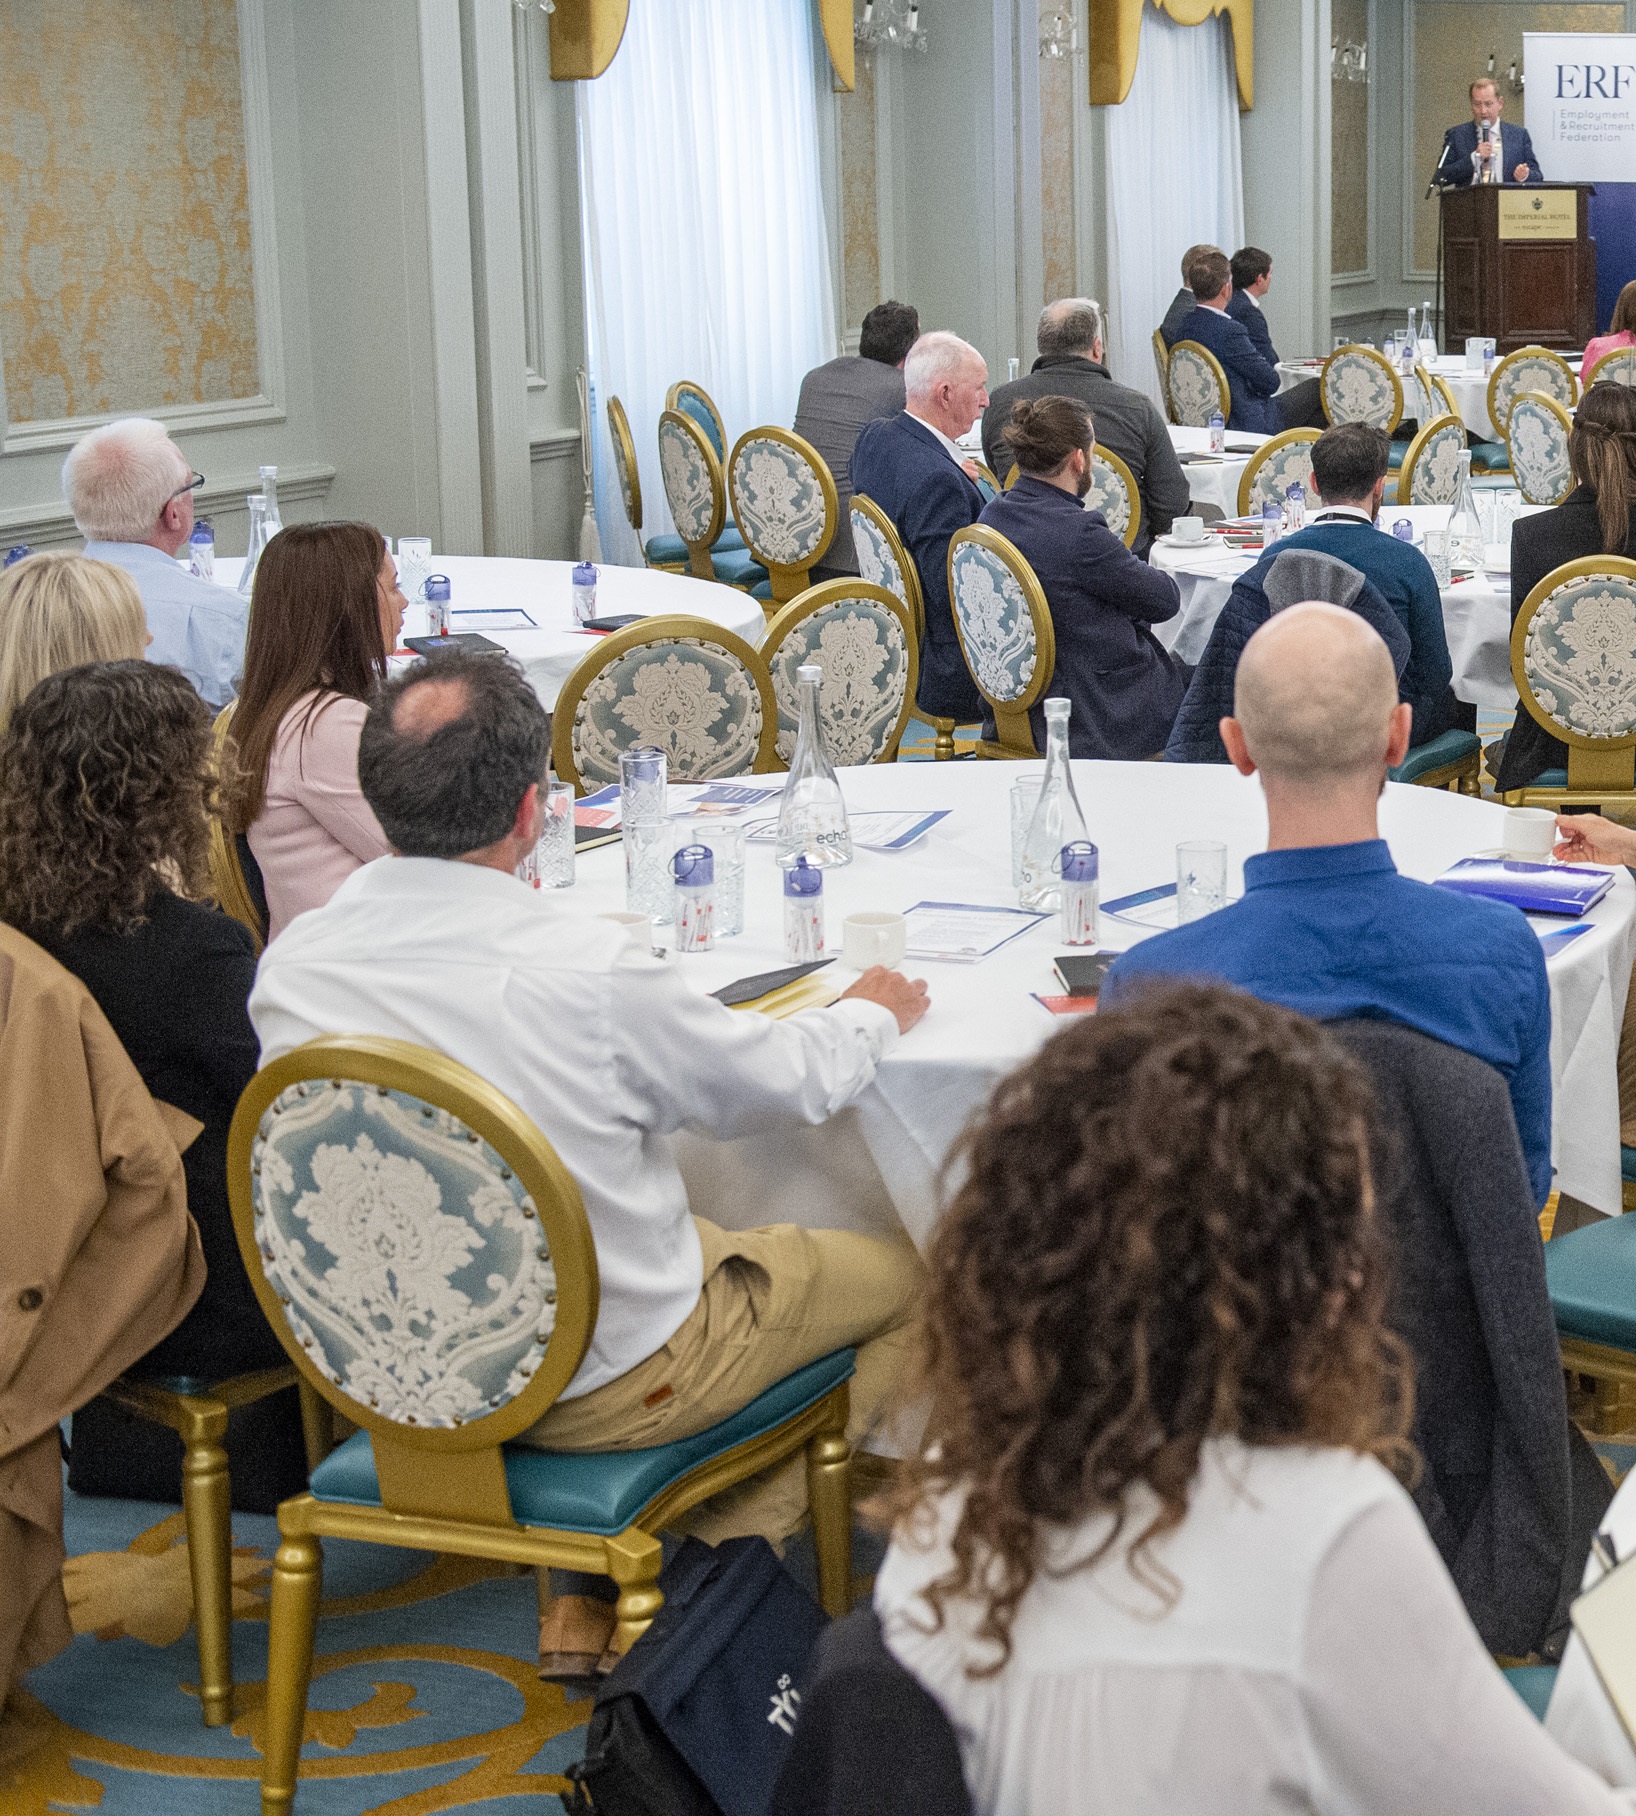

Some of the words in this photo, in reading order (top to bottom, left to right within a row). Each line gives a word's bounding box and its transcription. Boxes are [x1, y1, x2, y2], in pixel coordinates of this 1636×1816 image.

[1554, 64, 1636, 98] ERF
[1560, 109, 1630, 121] Employment
[1560, 121, 1567, 130] &
[1569, 121, 1635, 131] Recruitment
[1560, 132, 1620, 141] Federation
